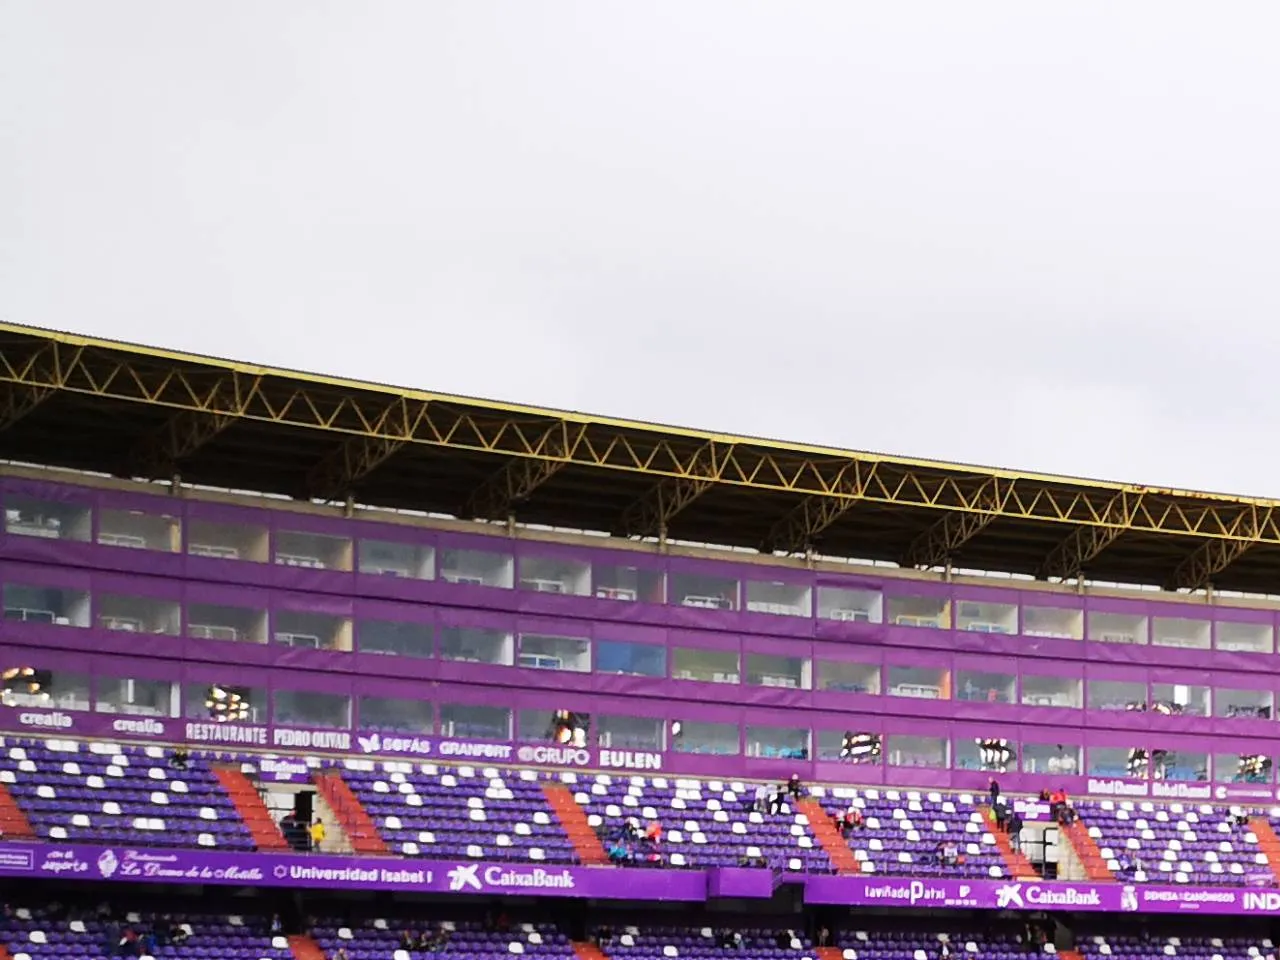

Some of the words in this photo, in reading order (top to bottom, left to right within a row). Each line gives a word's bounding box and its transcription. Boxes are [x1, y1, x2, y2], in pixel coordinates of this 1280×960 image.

[186, 722, 267, 745] RESTAURANTE
[273, 728, 310, 747] PEDRO
[312, 731, 351, 750] OLIVAR
[533, 745, 590, 766] GRUPO
[600, 750, 662, 769] EULEN
[291, 865, 378, 882] Universidad
[381, 869, 425, 883] Isabel
[485, 866, 575, 888] CaixaBank
[1026, 887, 1100, 905] CaixaBank
